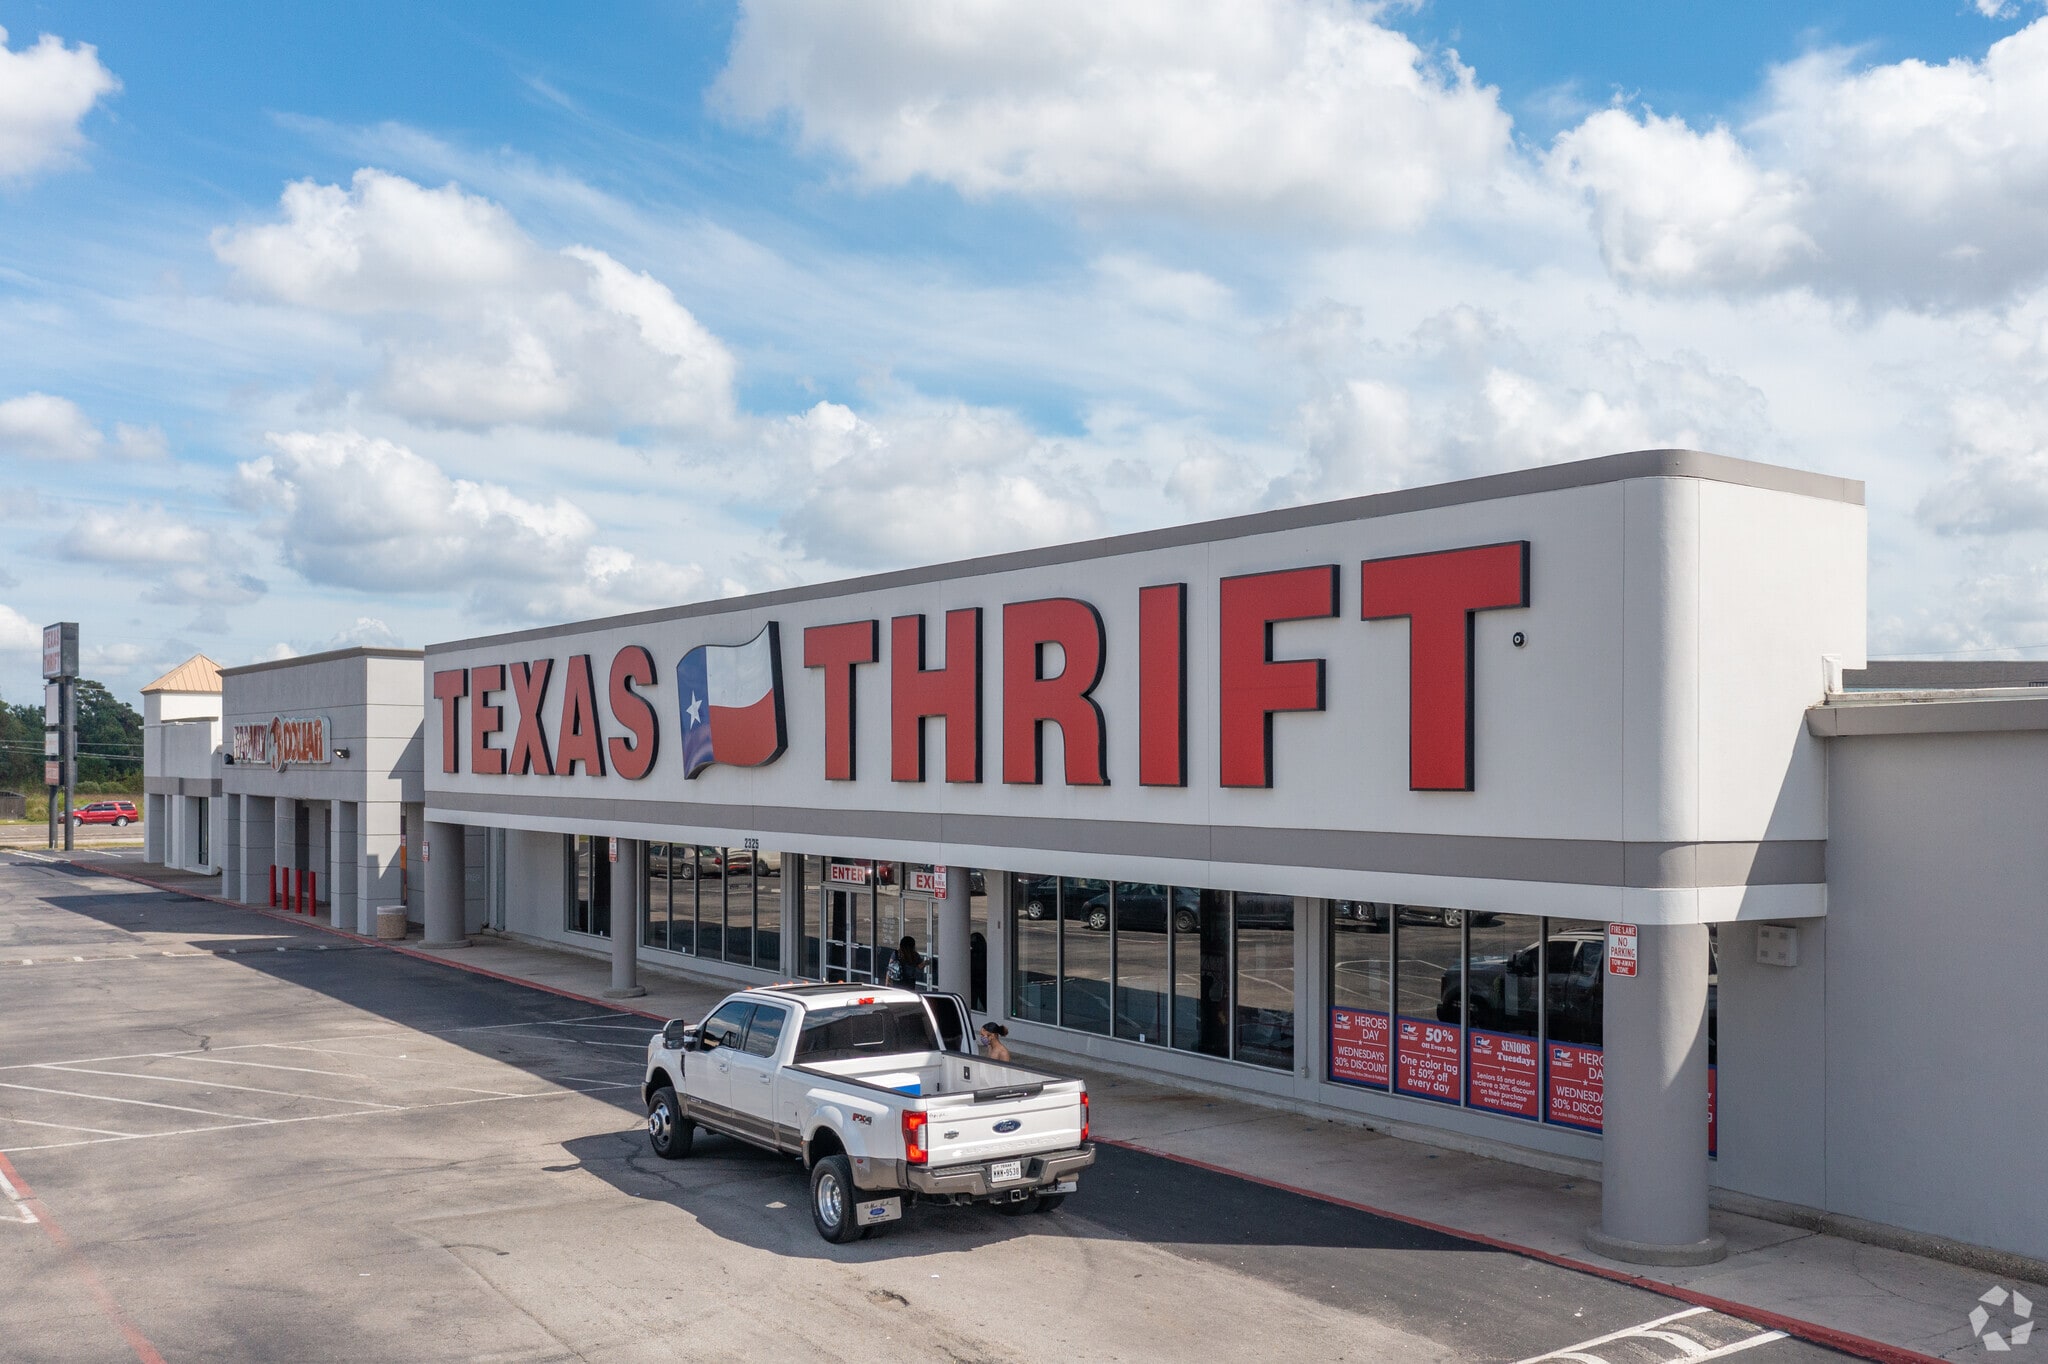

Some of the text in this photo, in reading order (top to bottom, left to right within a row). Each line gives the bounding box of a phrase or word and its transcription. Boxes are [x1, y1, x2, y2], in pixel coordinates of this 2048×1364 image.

[434, 540, 1530, 791] TEXAS THRIFT
[283, 719, 324, 761] DOLLAR
[744, 838, 759, 849] 2325
[832, 866, 864, 882] ENTER
[916, 874, 935, 889] EXI
[1611, 925, 1635, 935] FIRE LANE
[1618, 937, 1628, 946] NO
[1611, 946, 1635, 958] PARKING
[1355, 1015, 1388, 1030] HEROES
[1362, 1028, 1380, 1041] DAY
[1425, 1027, 1454, 1043] 50%
[1337, 1045, 1385, 1061] WEDNESDAYS
[1501, 1040, 1531, 1055] SENIORS
[1335, 1056, 1388, 1074] 30% DISCOUNT
[1400, 1054, 1458, 1075] One color tag
[1496, 1051, 1535, 1067] Tuesdays
[1409, 1066, 1448, 1082] is 50% off
[1476, 1071, 1495, 1081] Seniors
[1504, 1077, 1515, 1085] and
[1516, 1079, 1531, 1087] older
[1588, 1067, 1604, 1081] DA
[1407, 1078, 1450, 1095] every day
[1511, 1086, 1536, 1096] discount
[1555, 1085, 1604, 1103] WEDNESDA
[1483, 1097, 1524, 1110] every Tuesday
[1501, 1092, 1528, 1103] purchase
[1552, 1097, 1603, 1116] 30% DISCO
[852, 1112, 873, 1126] FX4
